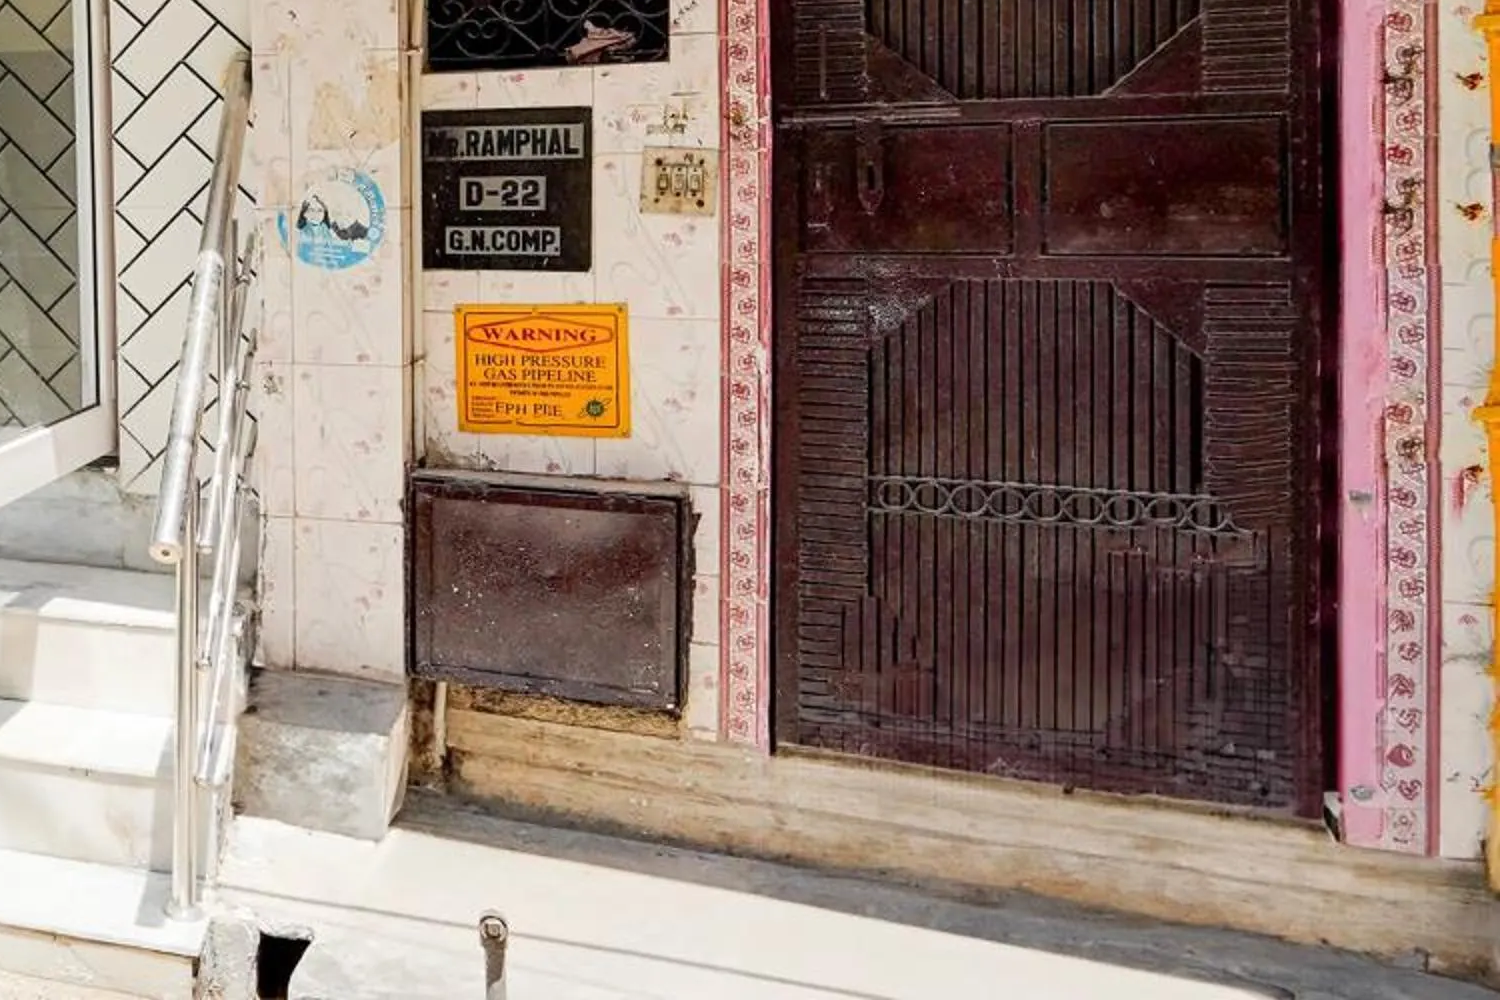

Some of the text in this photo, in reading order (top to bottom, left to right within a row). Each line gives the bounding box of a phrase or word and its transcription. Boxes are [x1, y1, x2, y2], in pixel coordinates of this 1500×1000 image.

[465, 179, 540, 207] D-22
[481, 327, 597, 343] WARNING
[474, 353, 607, 369] HIGH PRESSURE
[483, 367, 597, 383] GAS PIPELINE
